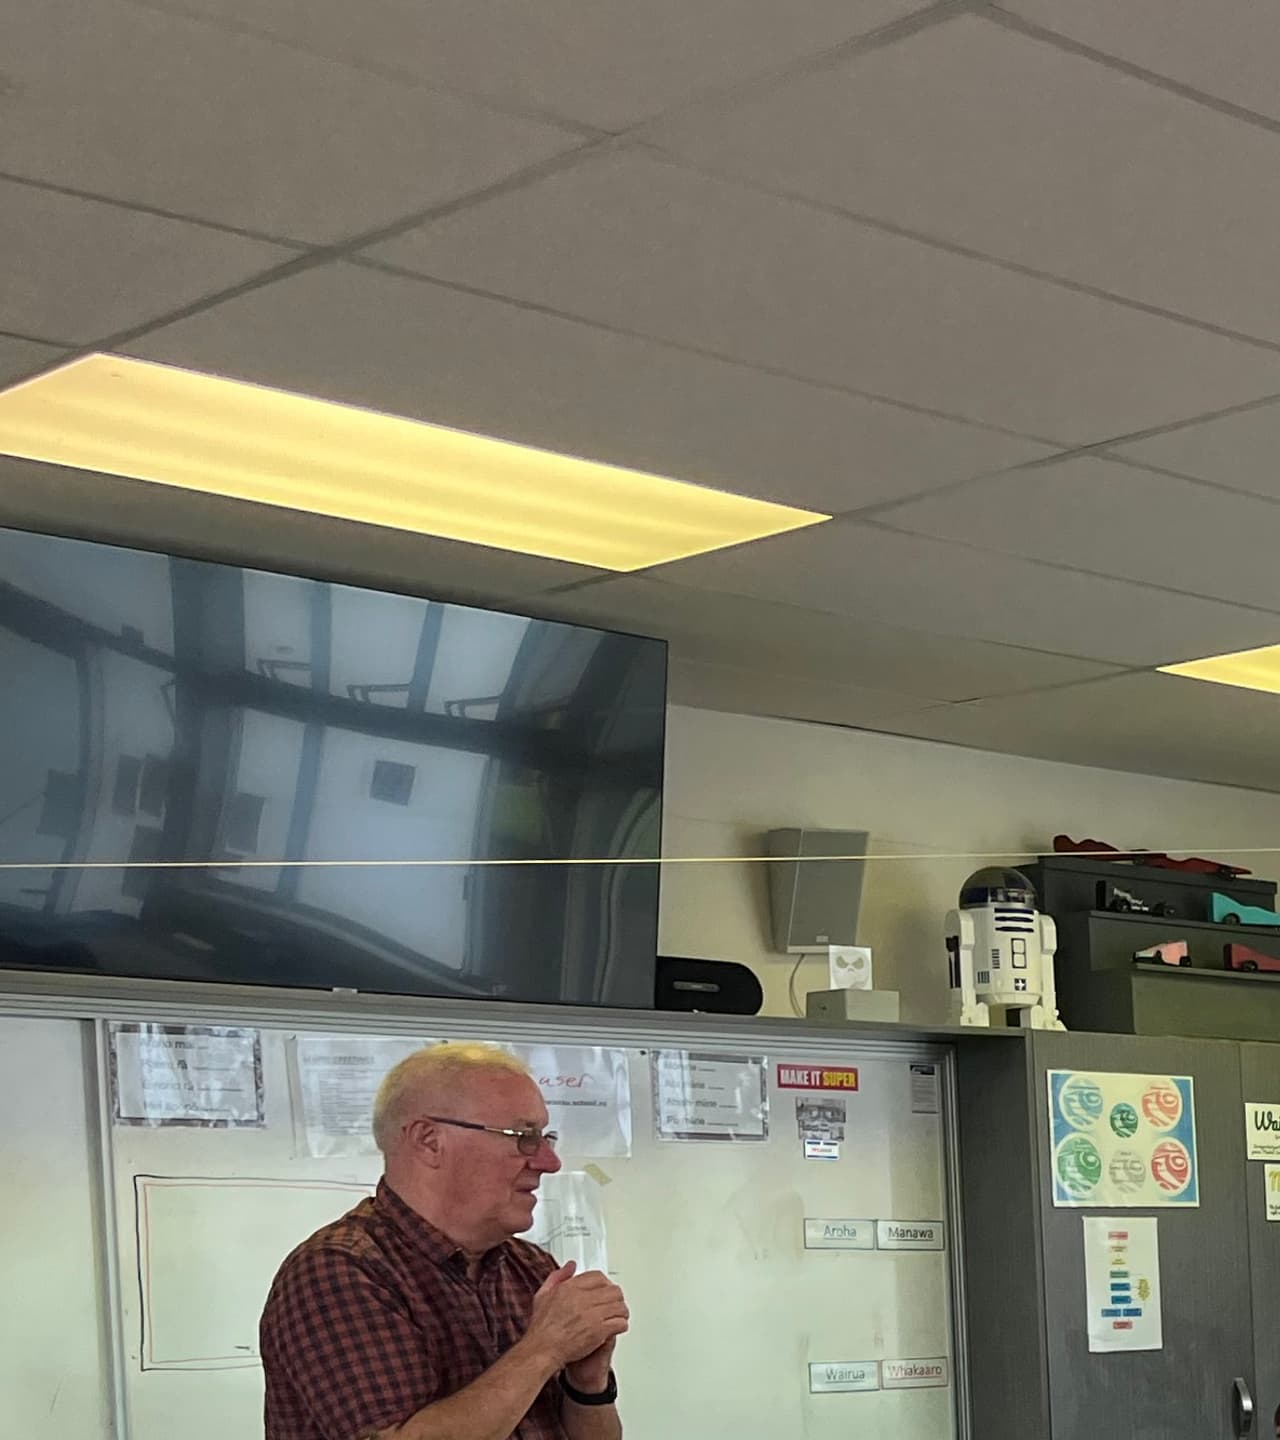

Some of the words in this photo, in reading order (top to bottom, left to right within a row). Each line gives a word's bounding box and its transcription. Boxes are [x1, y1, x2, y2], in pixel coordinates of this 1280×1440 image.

[780, 1069, 809, 1086] MAKE
[811, 1070, 821, 1086] IT
[822, 1071, 856, 1088] SUPER
[823, 1224, 857, 1238] Aroha
[888, 1226, 934, 1239] Manawa
[825, 1367, 866, 1380] Wairua
[888, 1364, 942, 1377] Whakaaro
